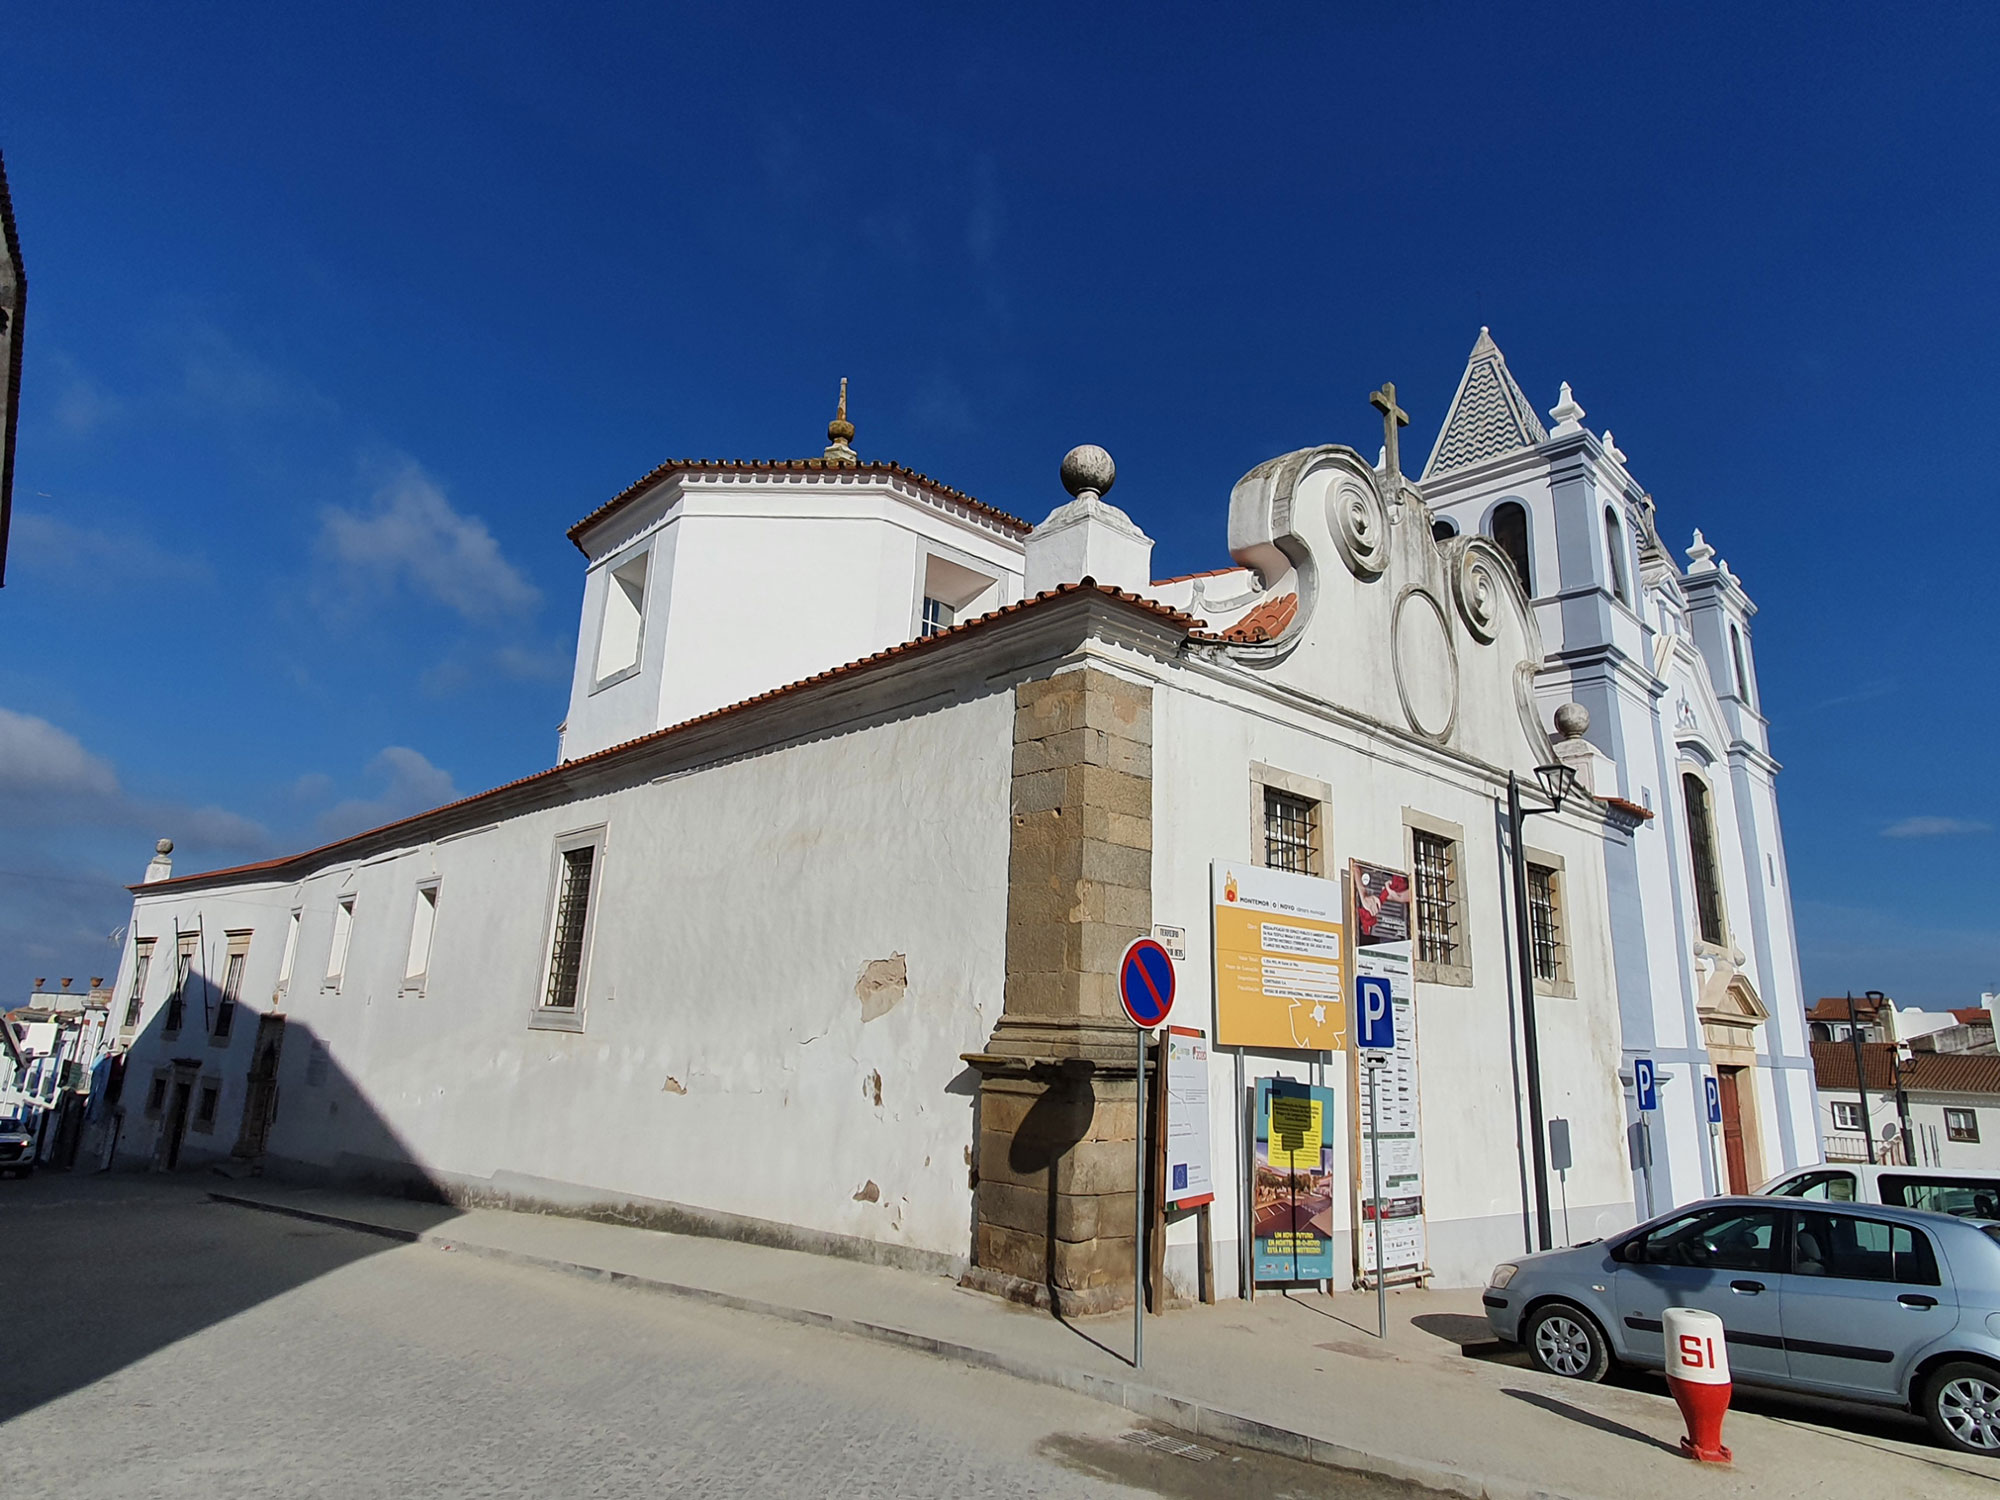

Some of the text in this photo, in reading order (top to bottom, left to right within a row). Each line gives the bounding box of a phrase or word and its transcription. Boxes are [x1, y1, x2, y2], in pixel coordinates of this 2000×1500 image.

[1240, 897, 1269, 907] MONTEMOR
[1280, 903, 1295, 911] NOVO
[1363, 982, 1385, 1041] P
[1638, 1064, 1651, 1106] P
[1706, 1081, 1716, 1118] P
[1679, 1334, 1715, 1369] SI
